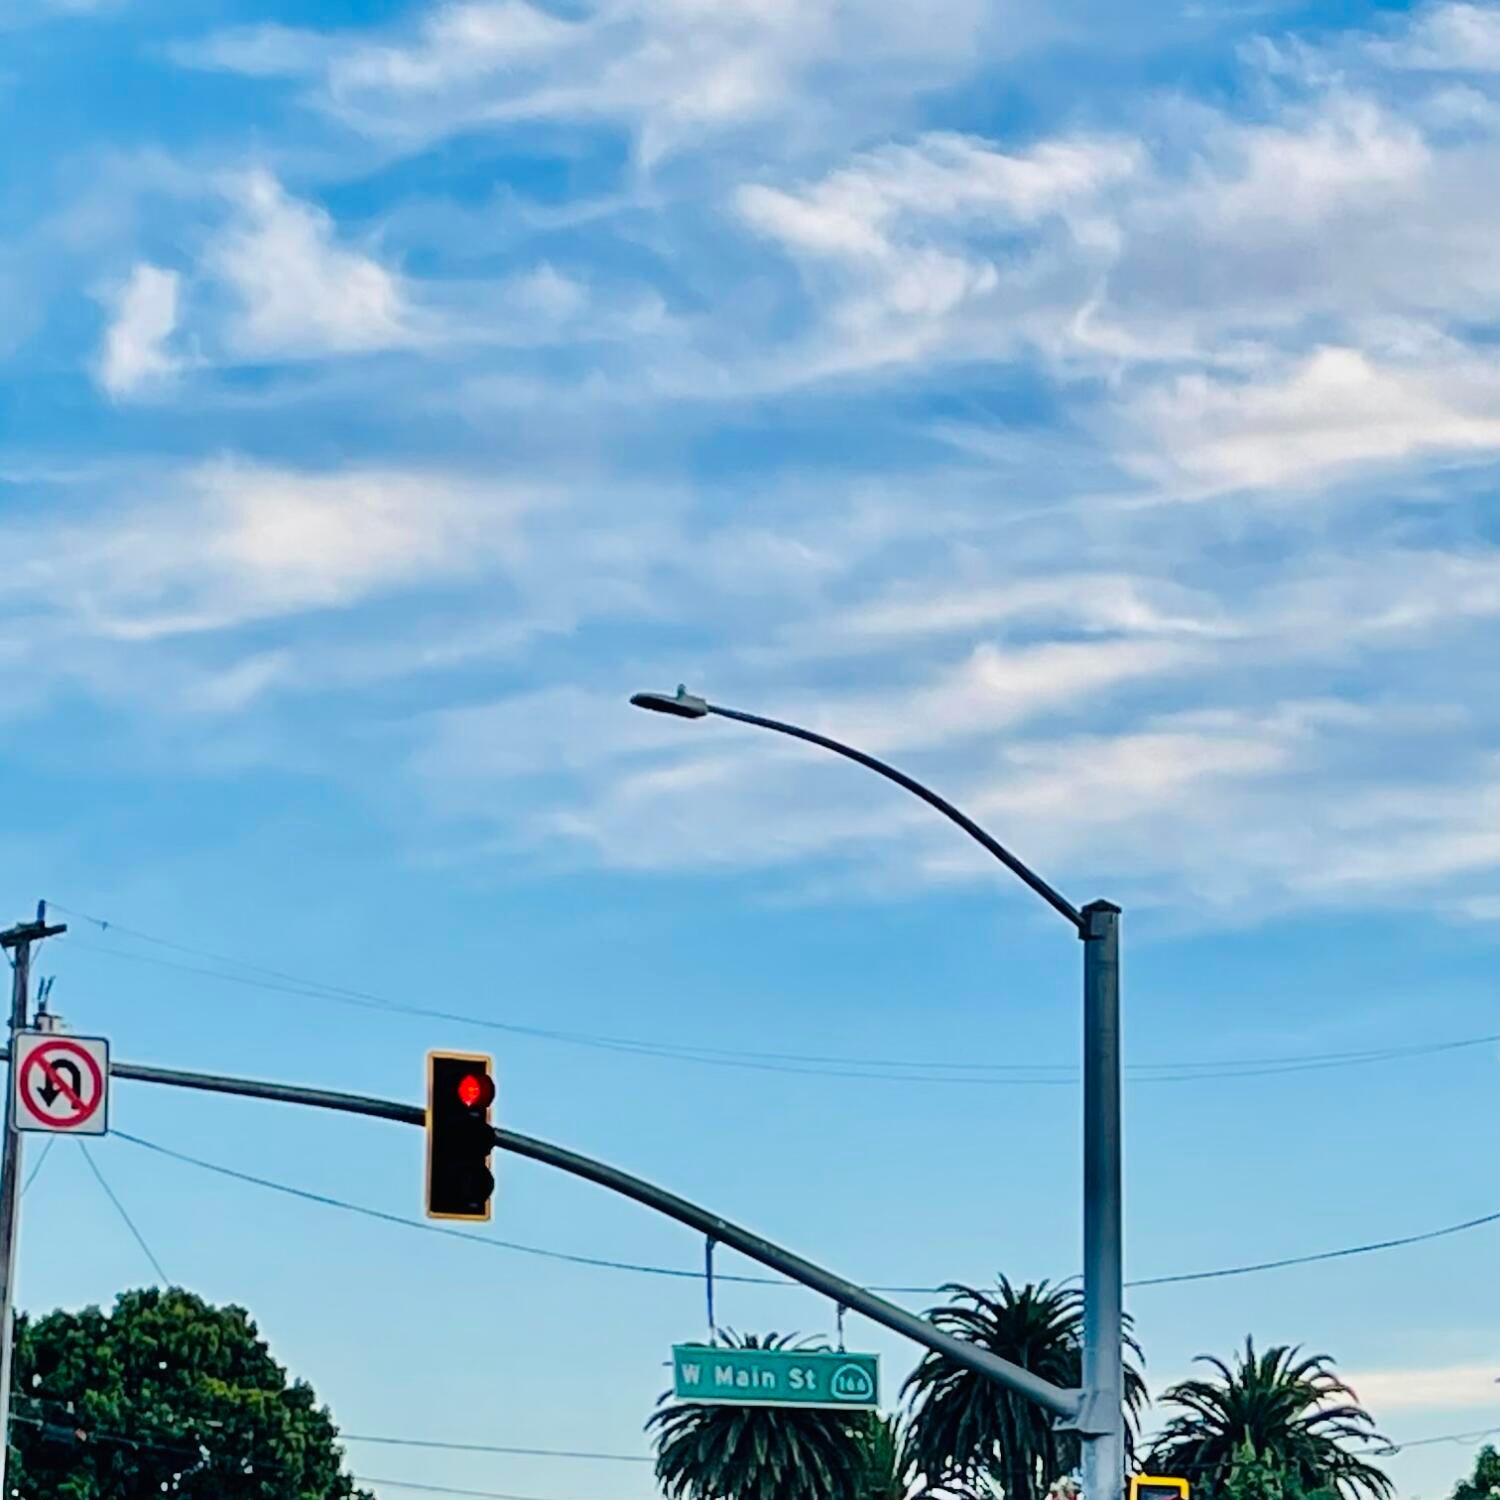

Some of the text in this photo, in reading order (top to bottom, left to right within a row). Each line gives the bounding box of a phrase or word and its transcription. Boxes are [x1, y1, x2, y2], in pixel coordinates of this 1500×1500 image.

[681, 1363, 701, 1385] W
[714, 1364, 776, 1389] Main
[788, 1368, 817, 1391] St
